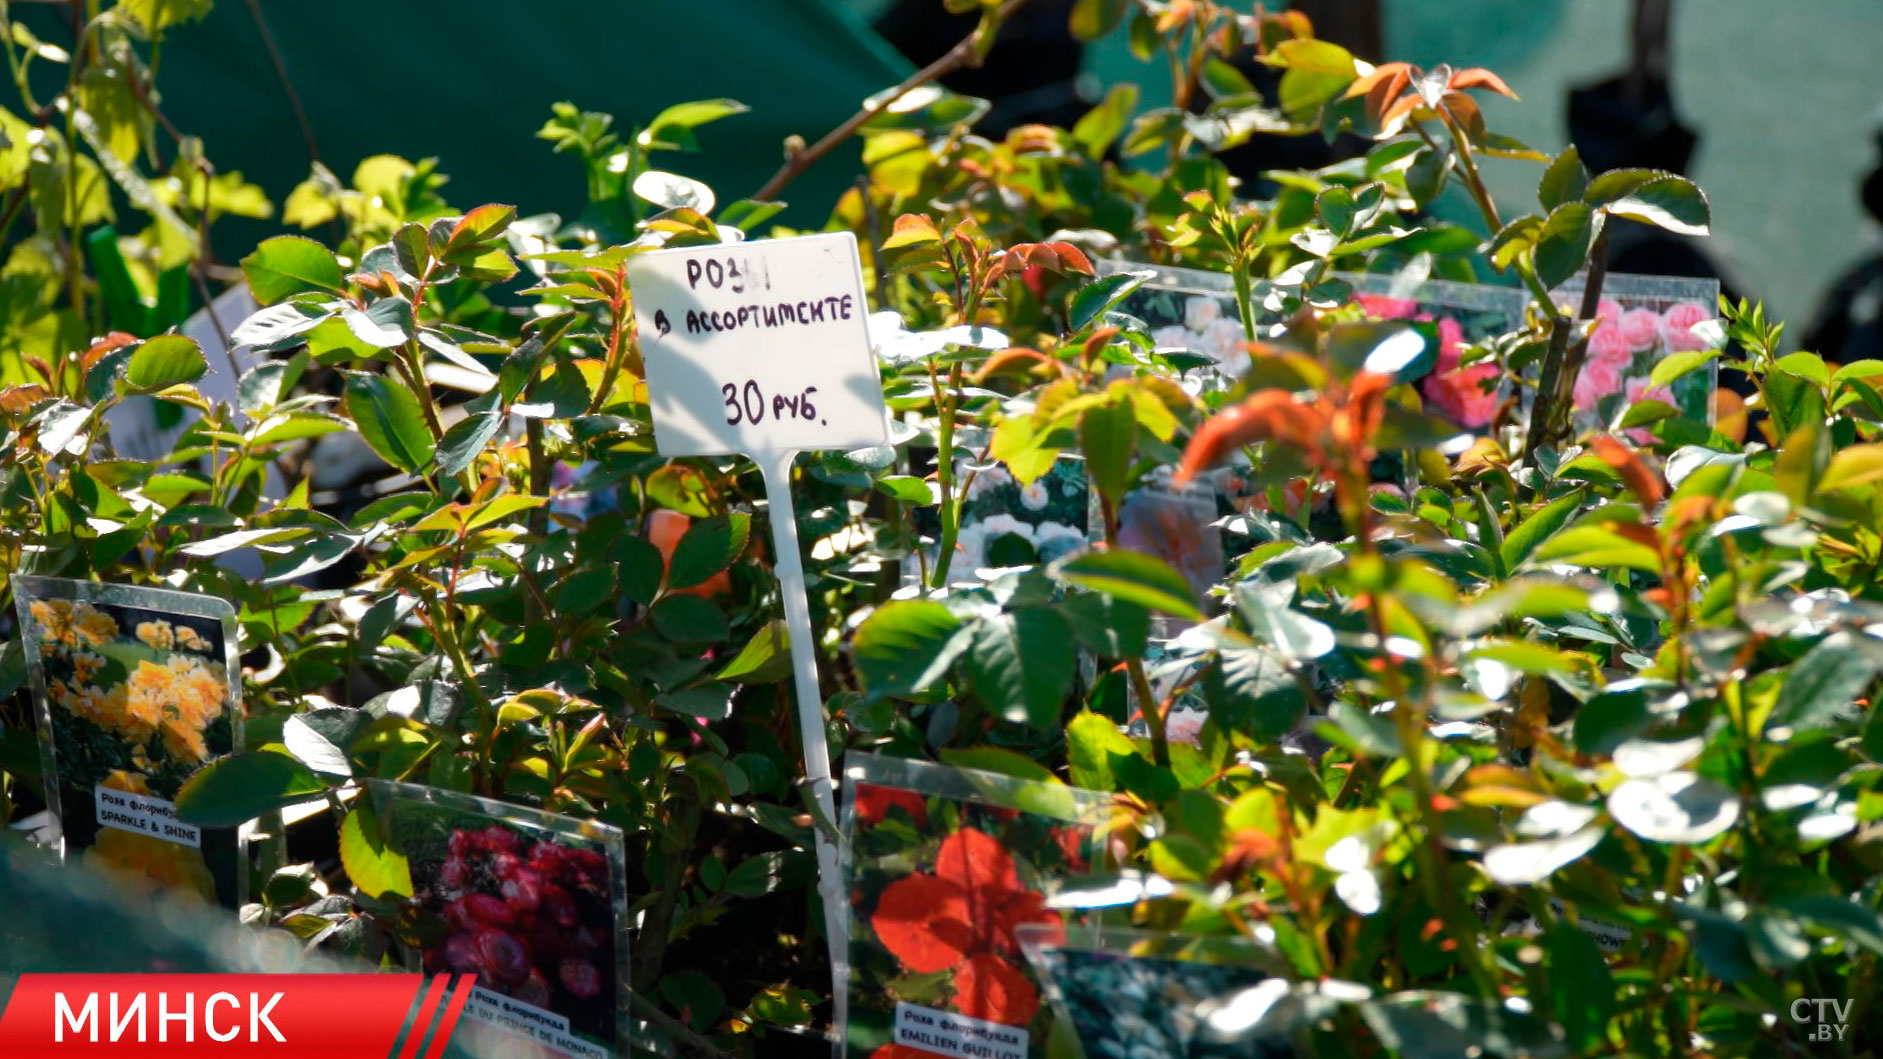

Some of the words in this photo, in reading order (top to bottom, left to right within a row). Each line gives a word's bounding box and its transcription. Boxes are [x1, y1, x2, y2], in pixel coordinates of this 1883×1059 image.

[722, 379, 765, 426] 30
[101, 810, 147, 830] SPARKLE
[151, 821, 159, 832] &
[164, 825, 197, 842] SHINE
[901, 1028, 958, 1051] EMILIEN
